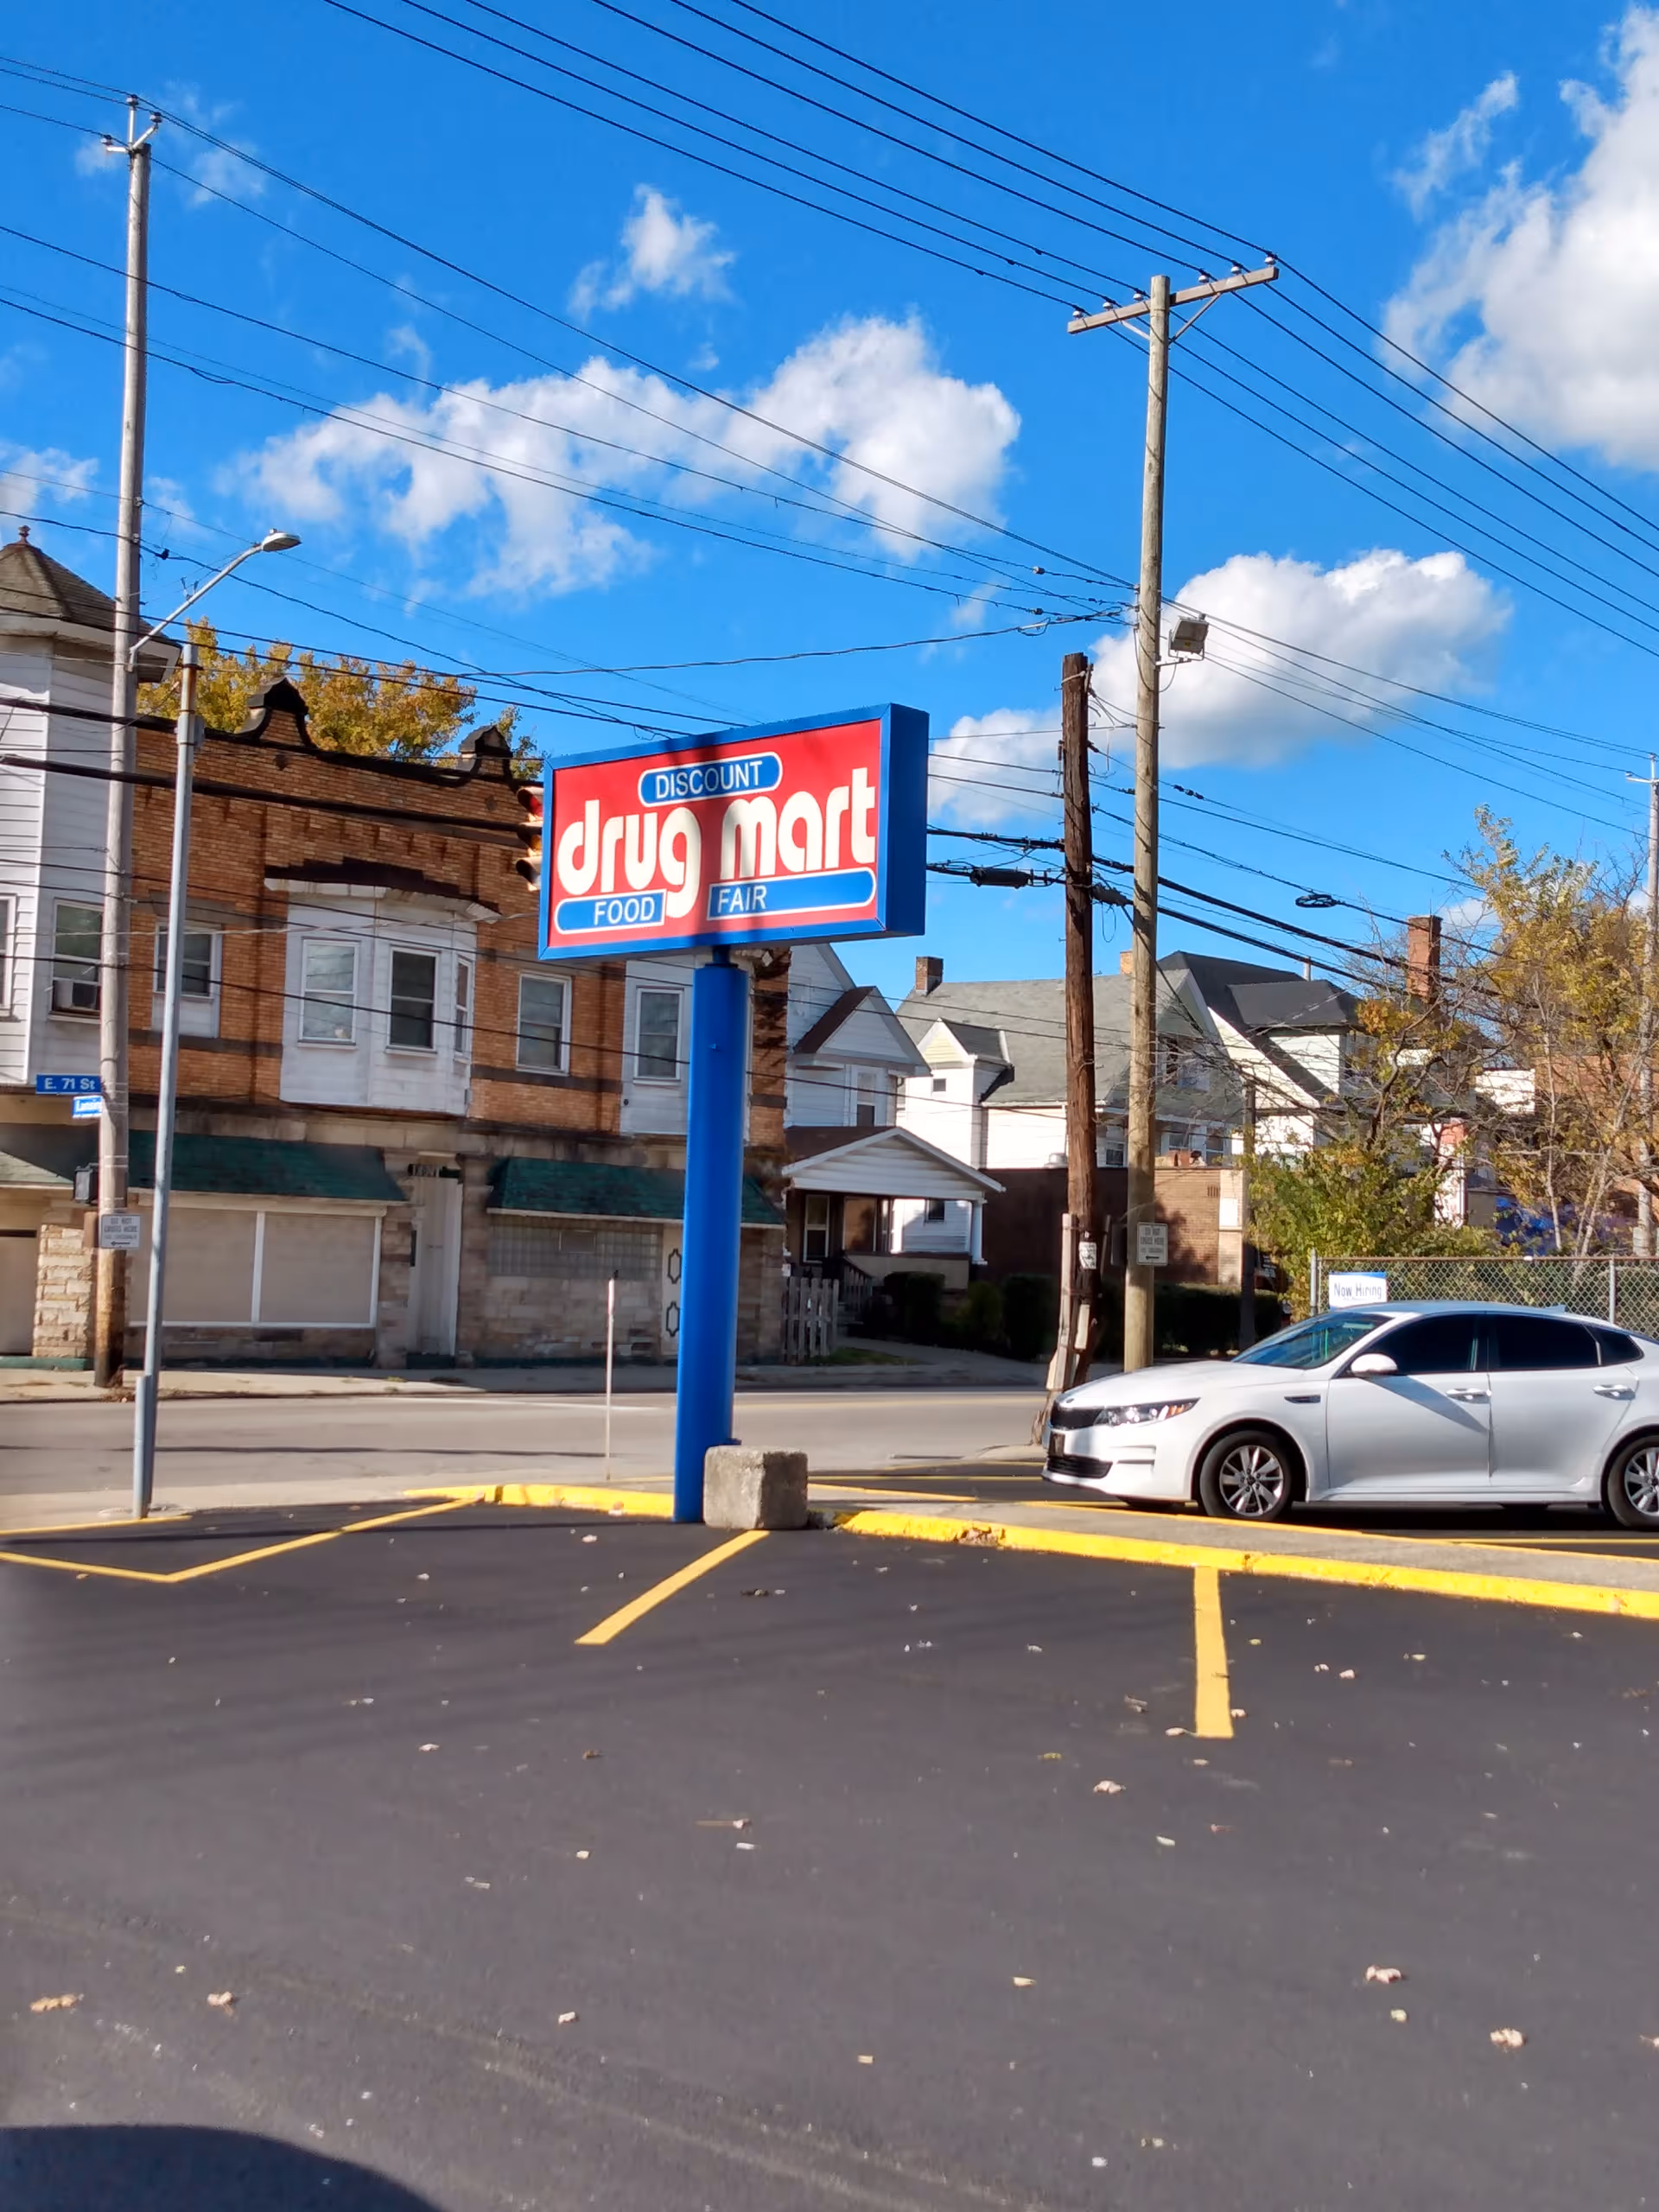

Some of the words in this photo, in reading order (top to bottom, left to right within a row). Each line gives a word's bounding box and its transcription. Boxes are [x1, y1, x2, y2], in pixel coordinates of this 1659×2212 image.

[655, 760, 763, 800] DISCOUNT
[556, 799, 702, 918] drug
[720, 766, 876, 880] mart
[594, 897, 655, 926] FOOD
[717, 885, 767, 912] FAIR
[60, 1077, 76, 1090] 71
[79, 1077, 96, 1090] St
[1333, 1282, 1353, 1297] Now
[1355, 1282, 1382, 1300] Hiring
